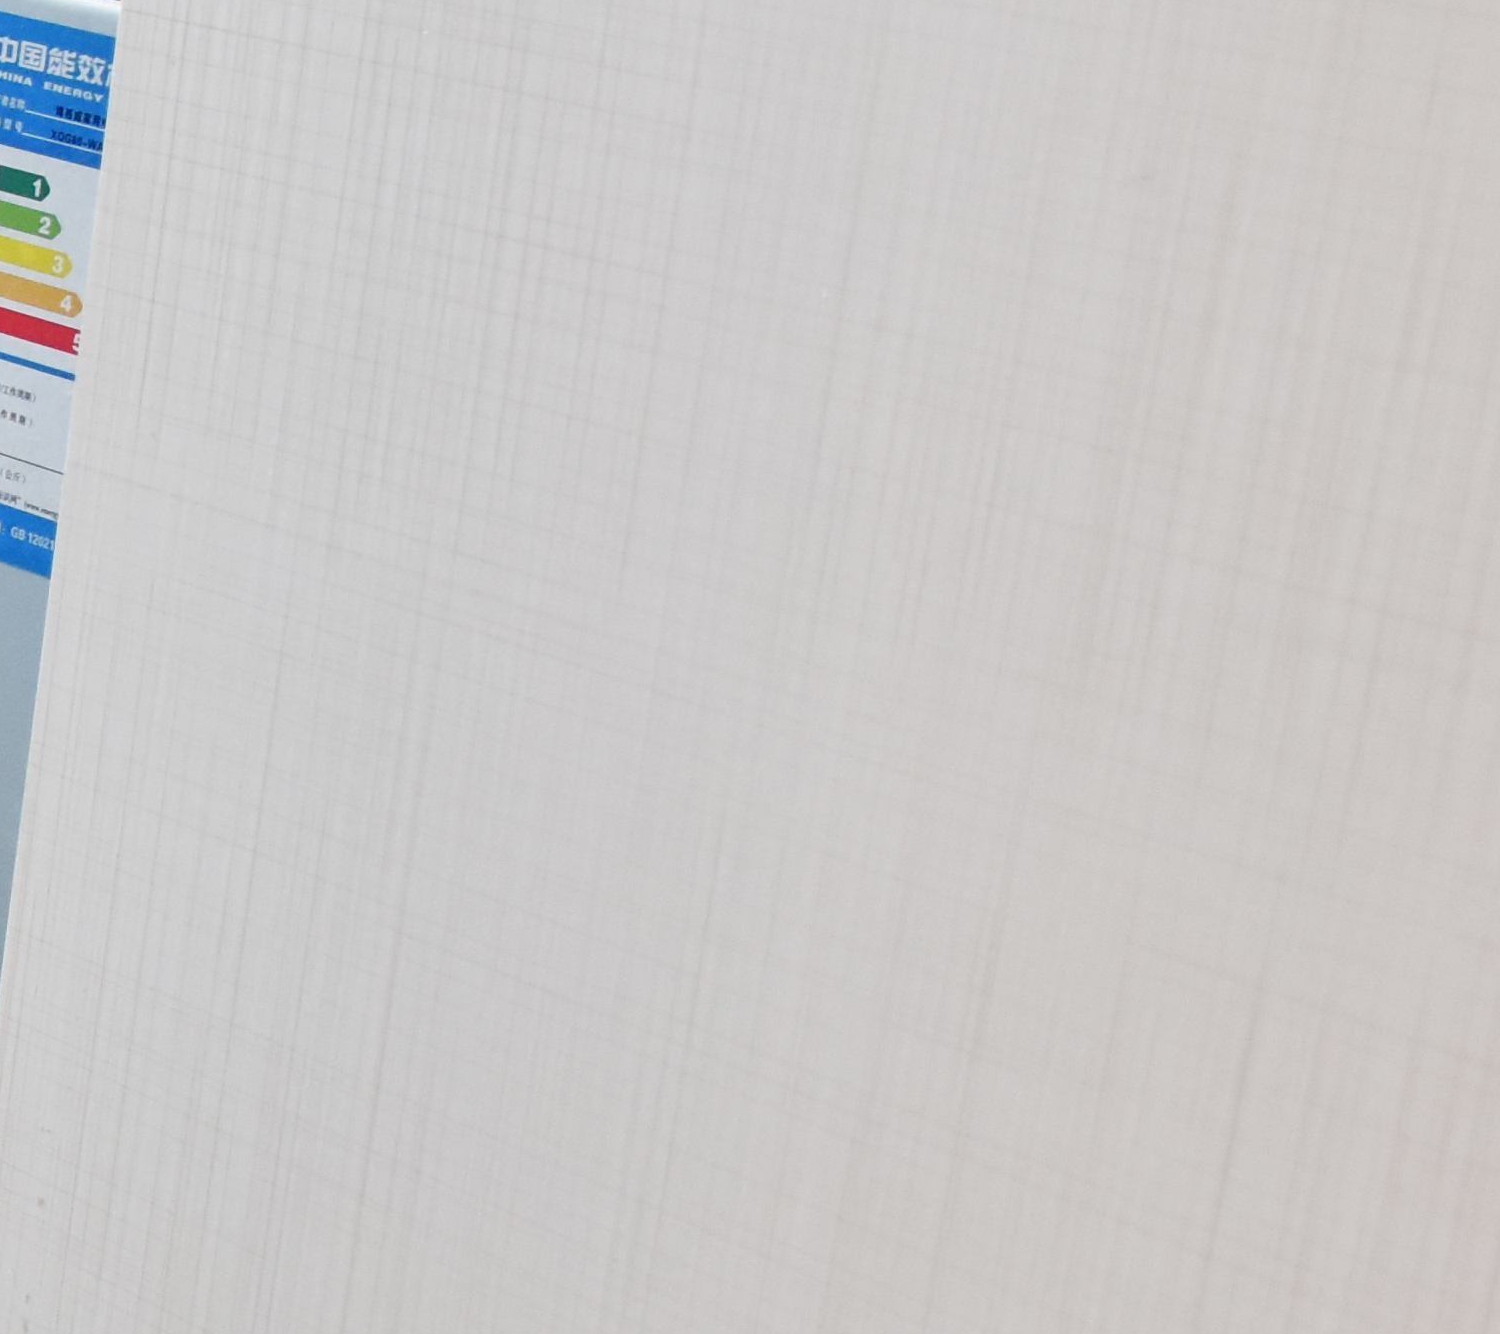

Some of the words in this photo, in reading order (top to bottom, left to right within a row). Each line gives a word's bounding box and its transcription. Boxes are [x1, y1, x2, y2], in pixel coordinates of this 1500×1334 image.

[43, 81, 104, 103] ENERGY
[32, 178, 43, 198] 1
[38, 216, 53, 236] 2
[52, 254, 65, 275] 3
[60, 294, 73, 313] 4
[10, 526, 27, 542] GB
